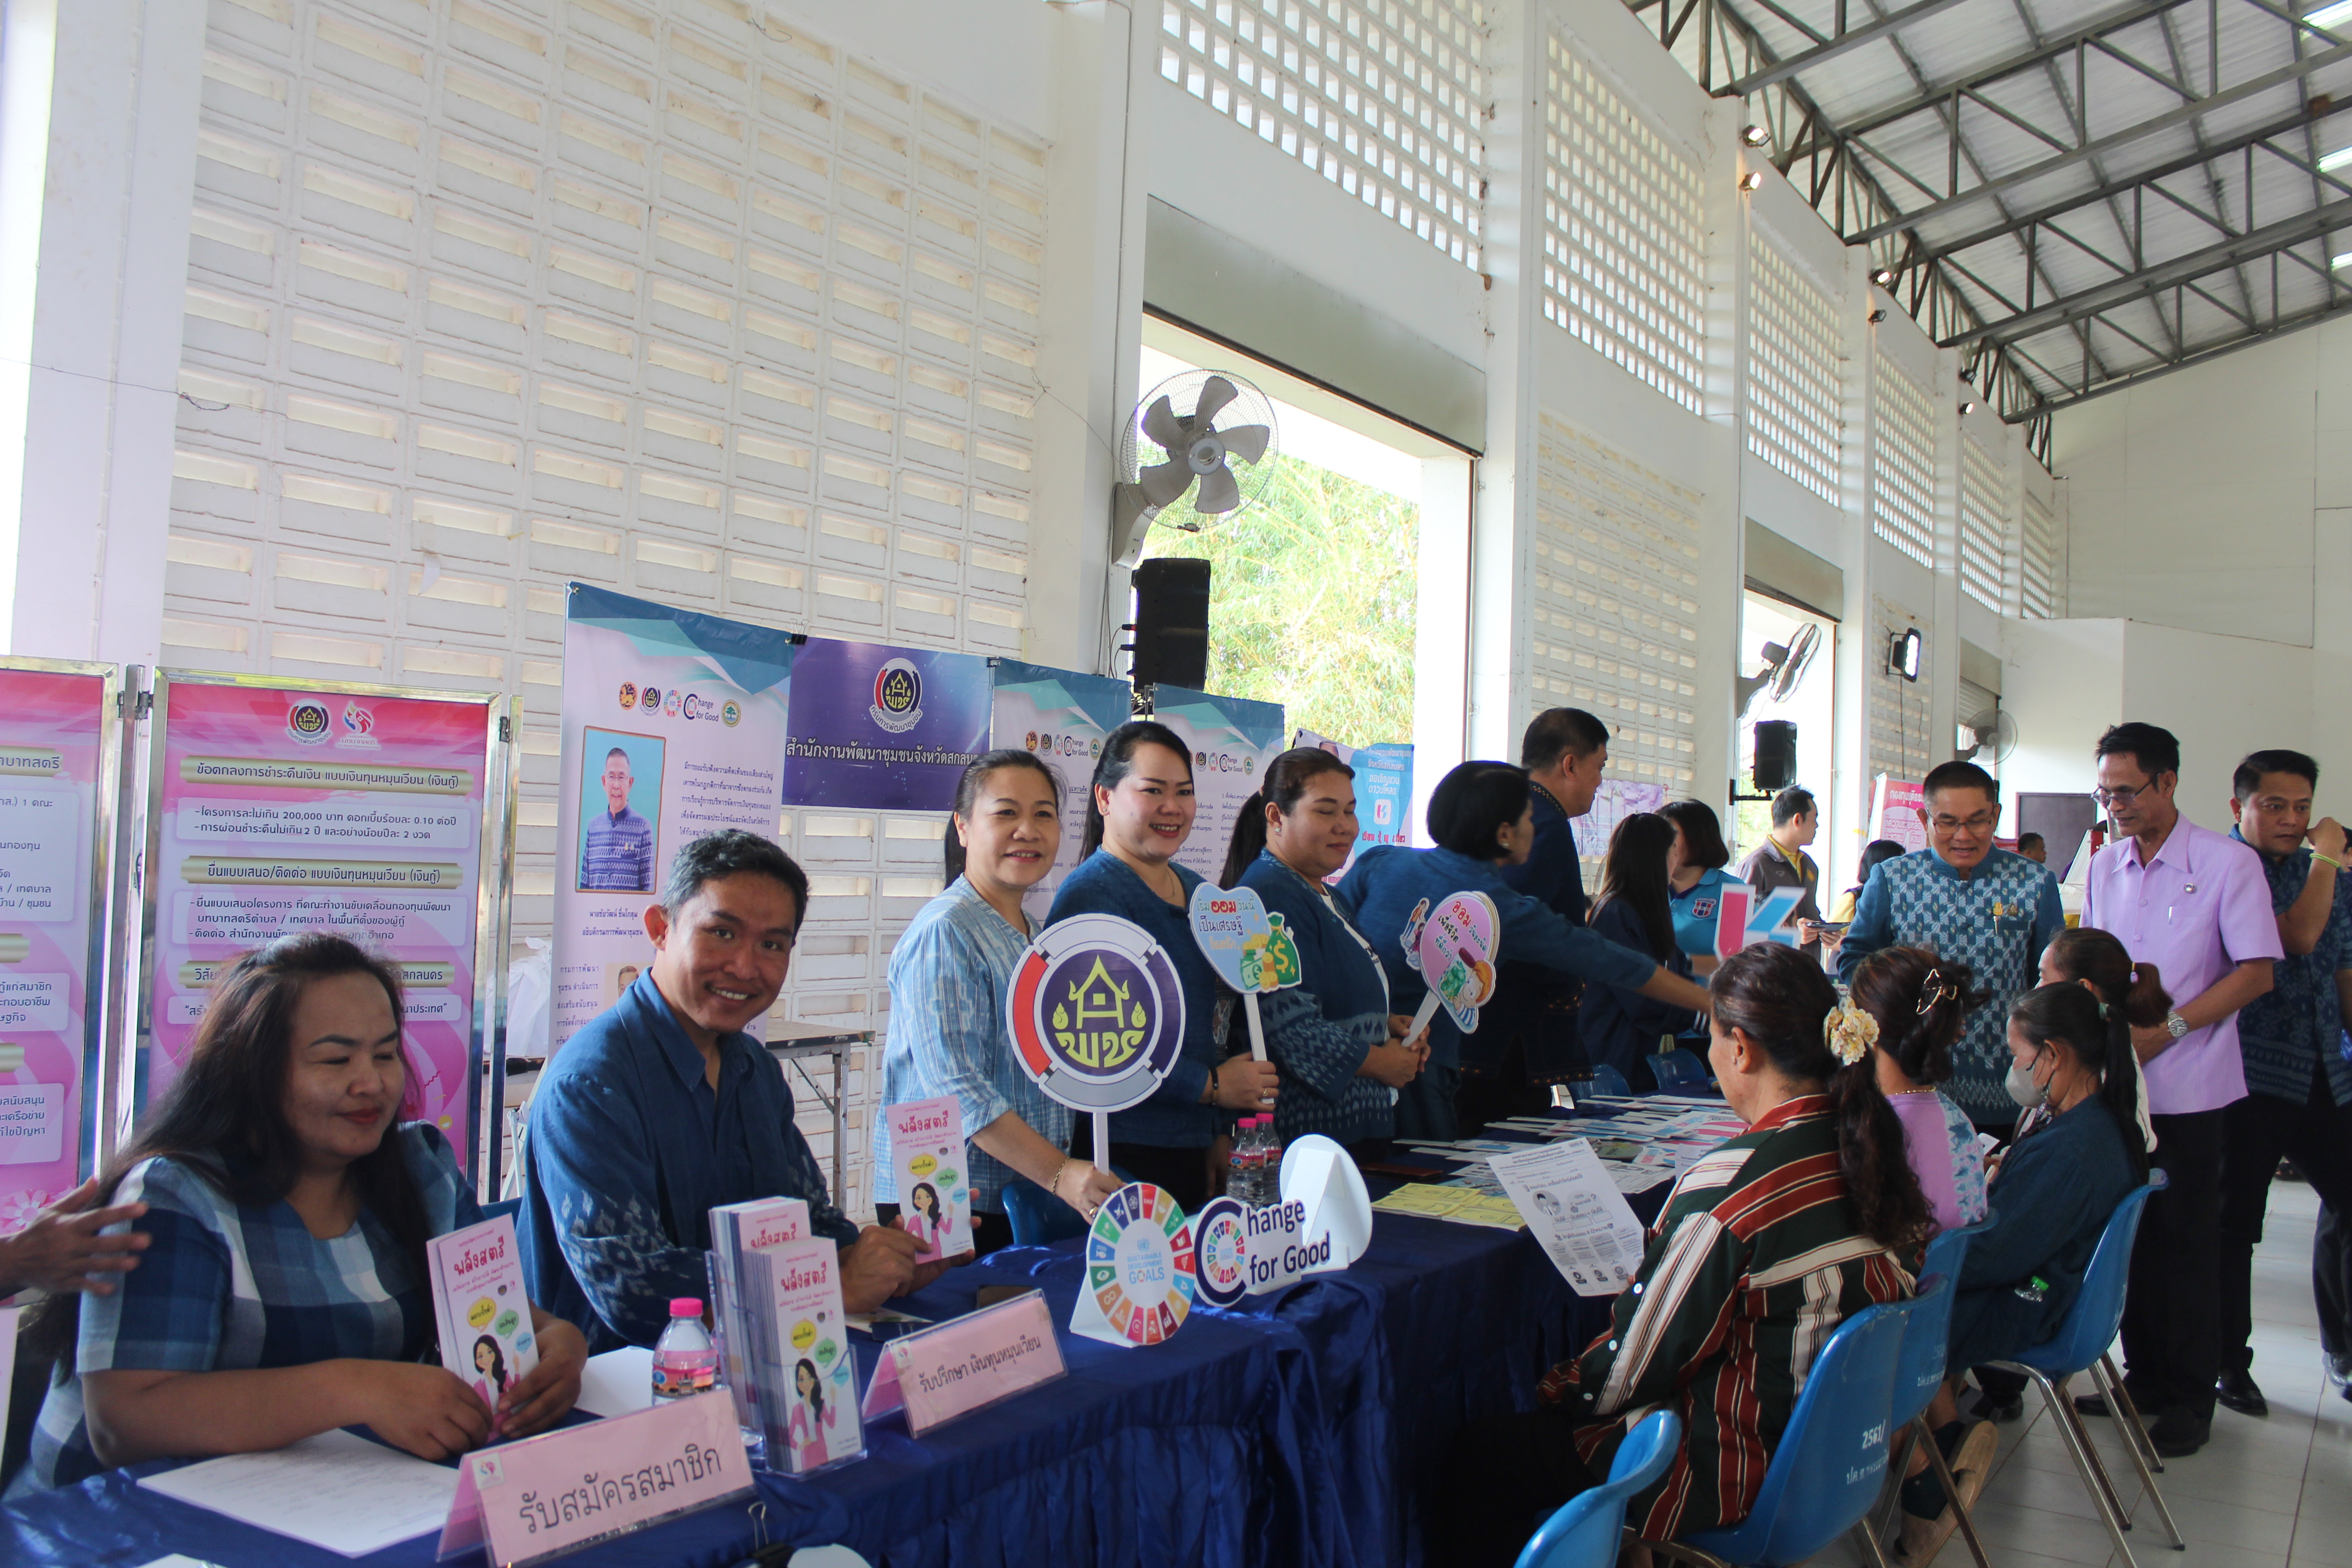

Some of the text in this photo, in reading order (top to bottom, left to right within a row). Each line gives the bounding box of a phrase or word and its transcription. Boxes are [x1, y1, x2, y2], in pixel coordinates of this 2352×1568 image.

[705, 713, 719, 721] Good
[197, 763, 459, 789] ข้อตกลงการชำระคืนเงิน แบบเงินทุนหมุนเวียน (เงินกู้)
[1369, 774, 1400, 785] ขอเชิญชวน
[1368, 784, 1397, 795] ดาวน์โหลด
[283, 811, 322, 821] 200,000
[326, 813, 343, 822] บาท
[347, 811, 411, 824] ดอกเบี้ยร้อยละ
[414, 817, 433, 825] 0.10
[437, 816, 456, 826] ต่อปี
[314, 826, 321, 835] ปี
[325, 827, 400, 838] และอย่างน้อยปีละ
[413, 831, 430, 839] งวด
[208, 861, 440, 884] ยื่นแบบเสนอ/ติดต่อ แบบเงินทุนหมุนเวียน (เงินกู้)
[27, 900, 51, 909] ชุมชน
[296, 897, 451, 912] ที่คณะทำงานขับเคลื่อนกองทุนพัฒนา
[1211, 901, 1236, 913] ออม
[1237, 893, 1255, 911] วันนี้
[198, 913, 277, 923] บทบาทสตรีตำบล
[290, 916, 324, 924] เทศบาล
[328, 912, 405, 927] ในพื้นที่ตั้งของผู้กู้
[1452, 902, 1471, 927] ออม
[583, 926, 643, 938] อธิบดีกรมการพัฒนาชุมชน
[1199, 915, 1243, 936] เป็นเศรษฐี
[560, 964, 599, 973] กรมการพัฒนา
[898, 1110, 948, 1133] พลังสตรี
[454, 1235, 504, 1275] พลังสตรี
[1127, 1252, 1162, 1263] SUSTAINABLE
[1250, 1232, 1330, 1284] for Good
[1128, 1259, 1162, 1270] DEVELOPMENT
[1129, 1267, 1165, 1284] GOALS
[970, 1334, 1041, 1374] เงินทุนหมุนเวียน
[519, 1443, 723, 1534] รับสมัครสมาชิก
